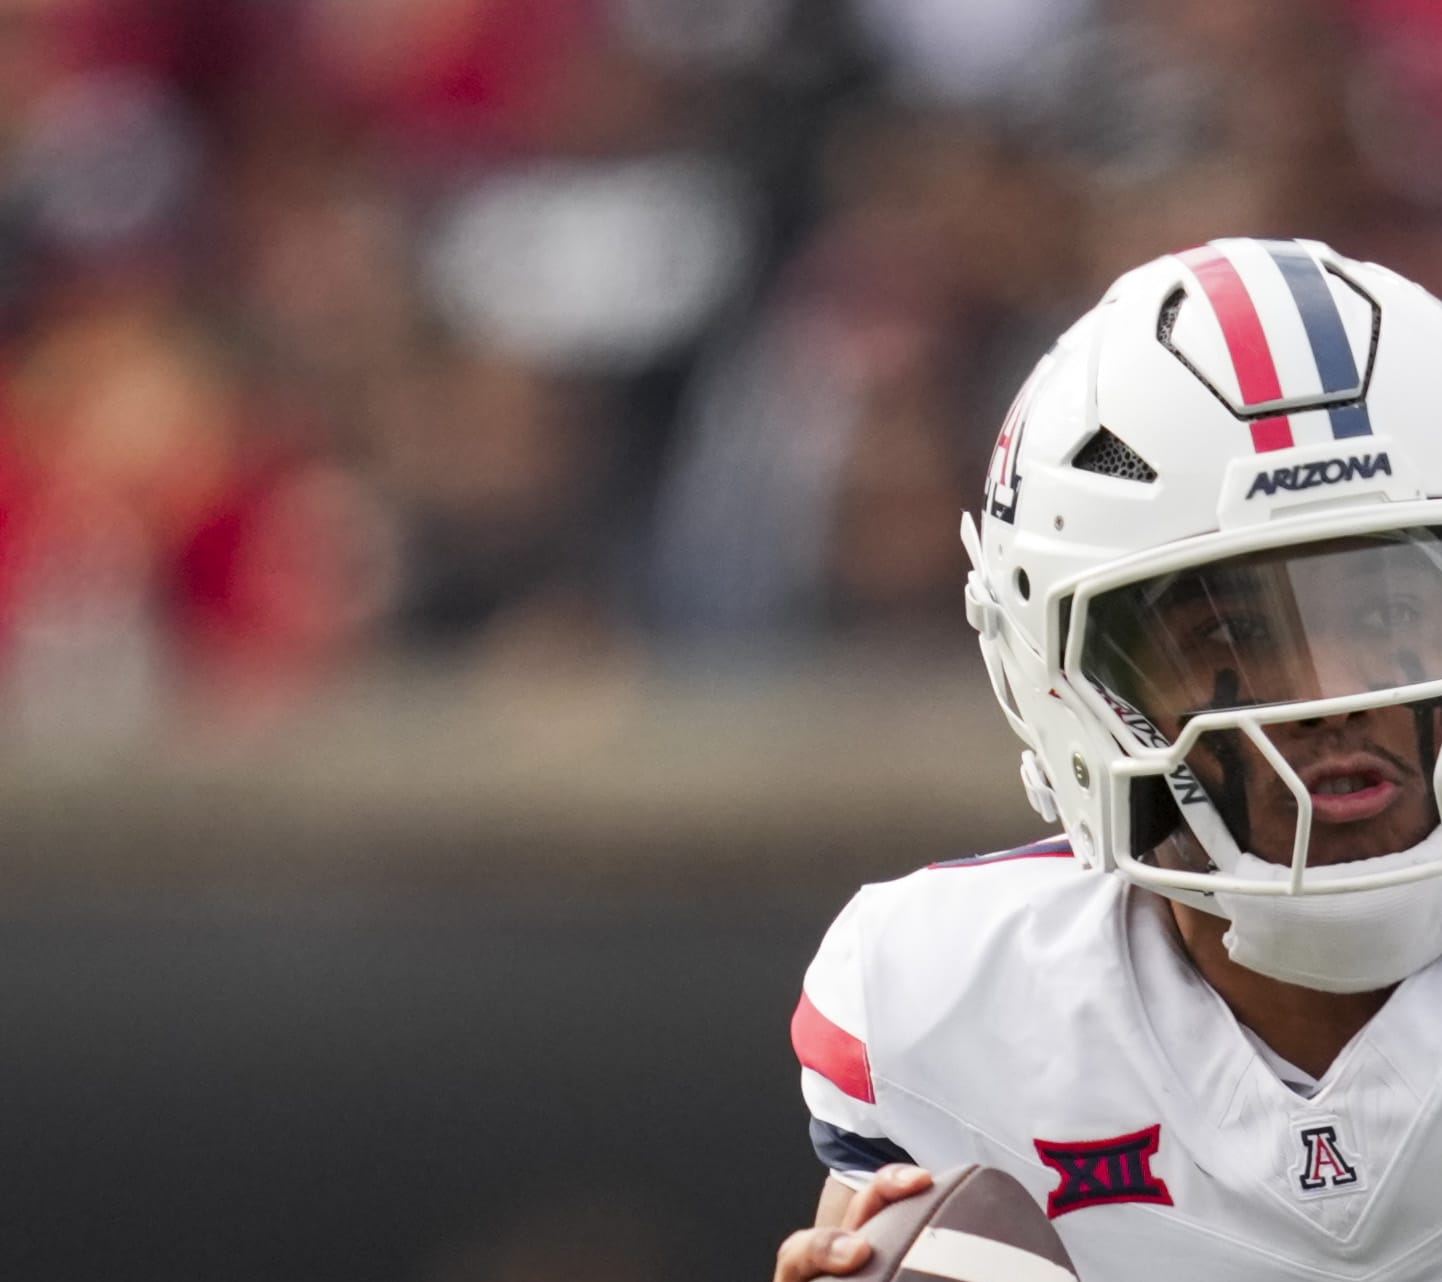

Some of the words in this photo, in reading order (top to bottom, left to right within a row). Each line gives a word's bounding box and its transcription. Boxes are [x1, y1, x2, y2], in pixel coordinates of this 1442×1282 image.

[1245, 451, 1392, 500] ARIZONA
[1042, 1135, 1163, 1210] XII
[1299, 1125, 1358, 1191] A
